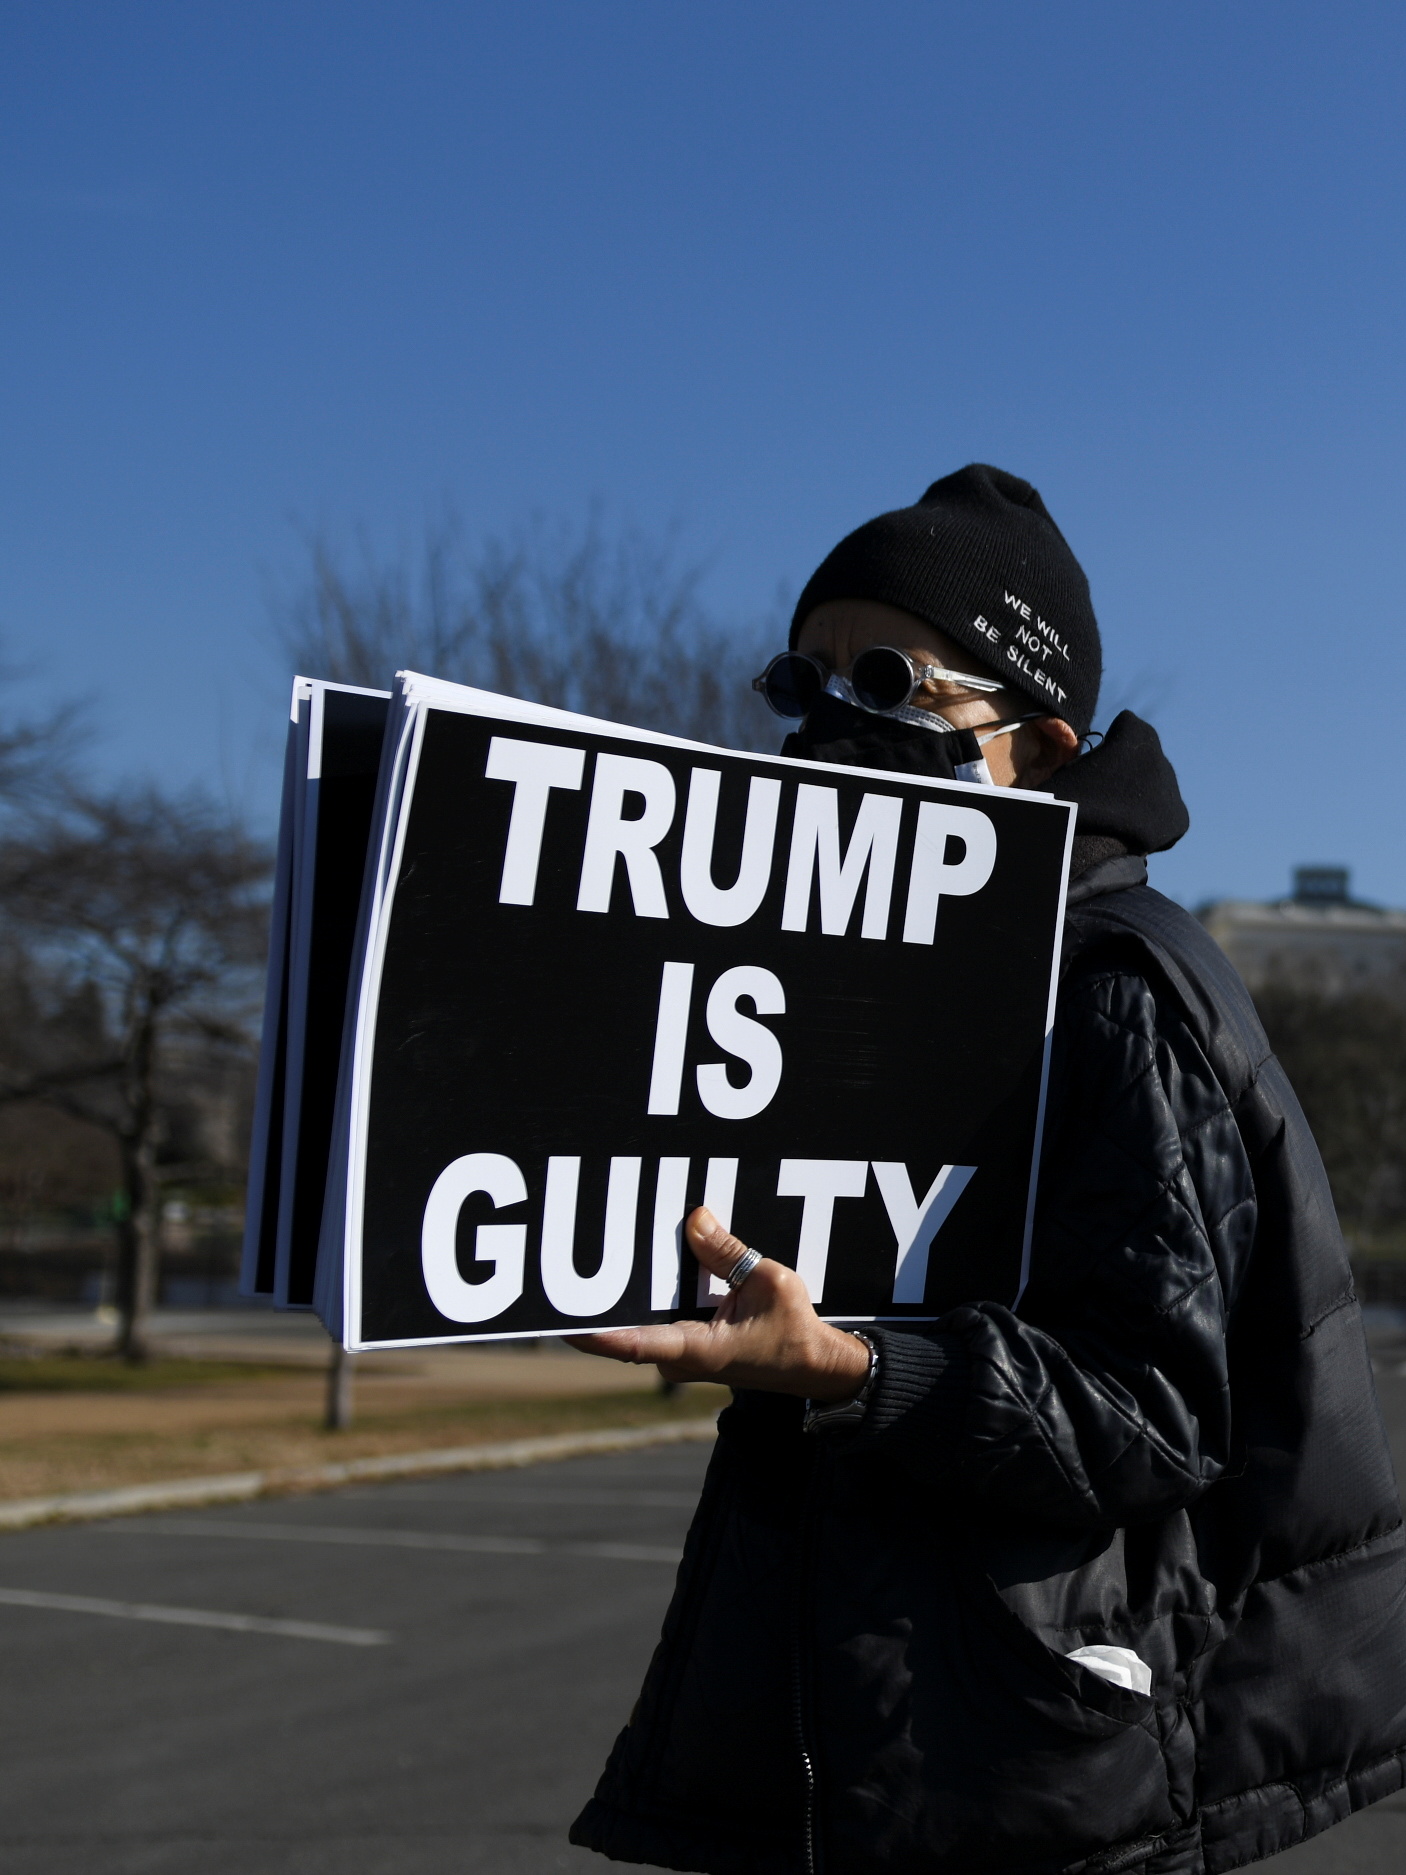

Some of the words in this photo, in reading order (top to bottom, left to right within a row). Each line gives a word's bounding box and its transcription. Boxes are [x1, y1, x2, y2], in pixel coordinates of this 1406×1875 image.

[973, 615, 1001, 643] BE
[1007, 645, 1067, 703] SILENT
[1004, 589, 1032, 621] WE
[1037, 616, 1070, 662] WILL
[1015, 625, 1053, 662] NOT
[484, 736, 998, 946] TRUMP
[647, 961, 786, 1120] IS
